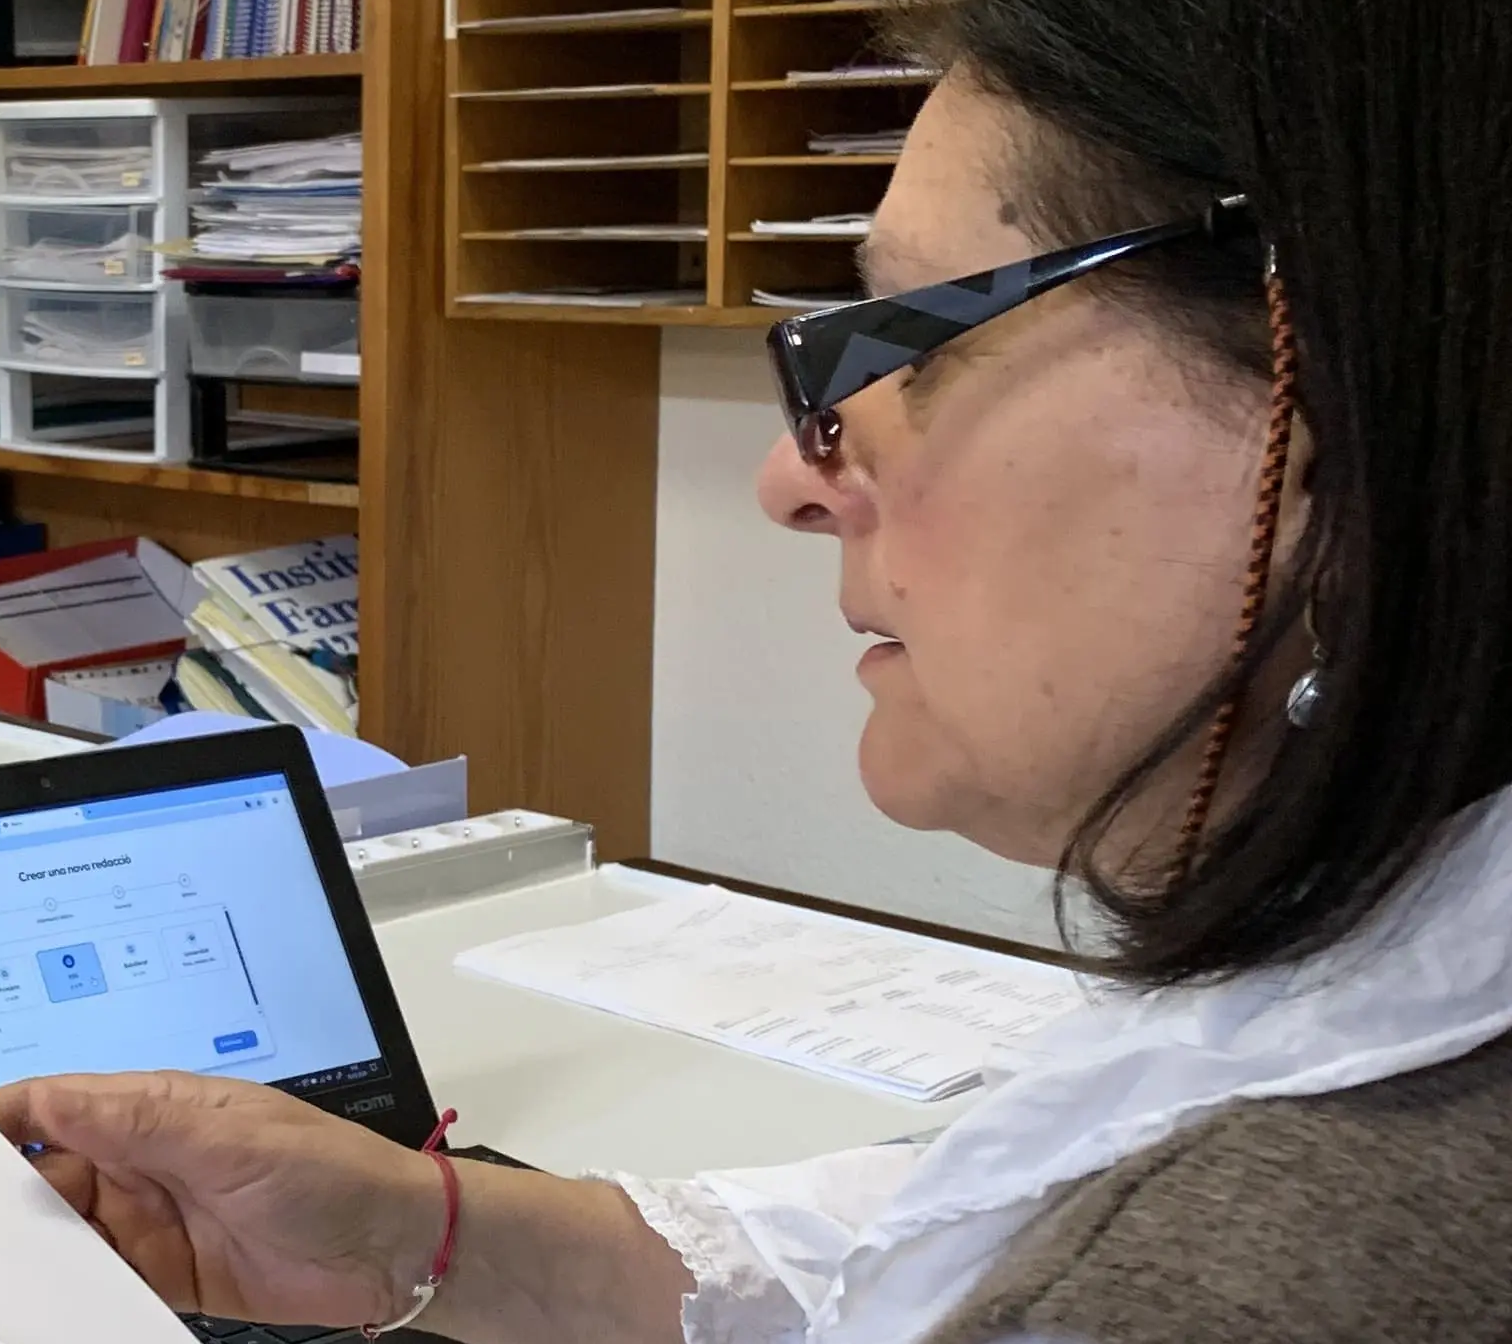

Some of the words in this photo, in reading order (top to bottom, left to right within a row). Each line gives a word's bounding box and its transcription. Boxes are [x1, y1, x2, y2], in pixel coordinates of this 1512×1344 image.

[18, 870, 47, 882] Crear
[48, 867, 67, 878] una
[67, 861, 91, 875] nova
[91, 853, 132, 870] redacció
[344, 1092, 396, 1116] HDMI
